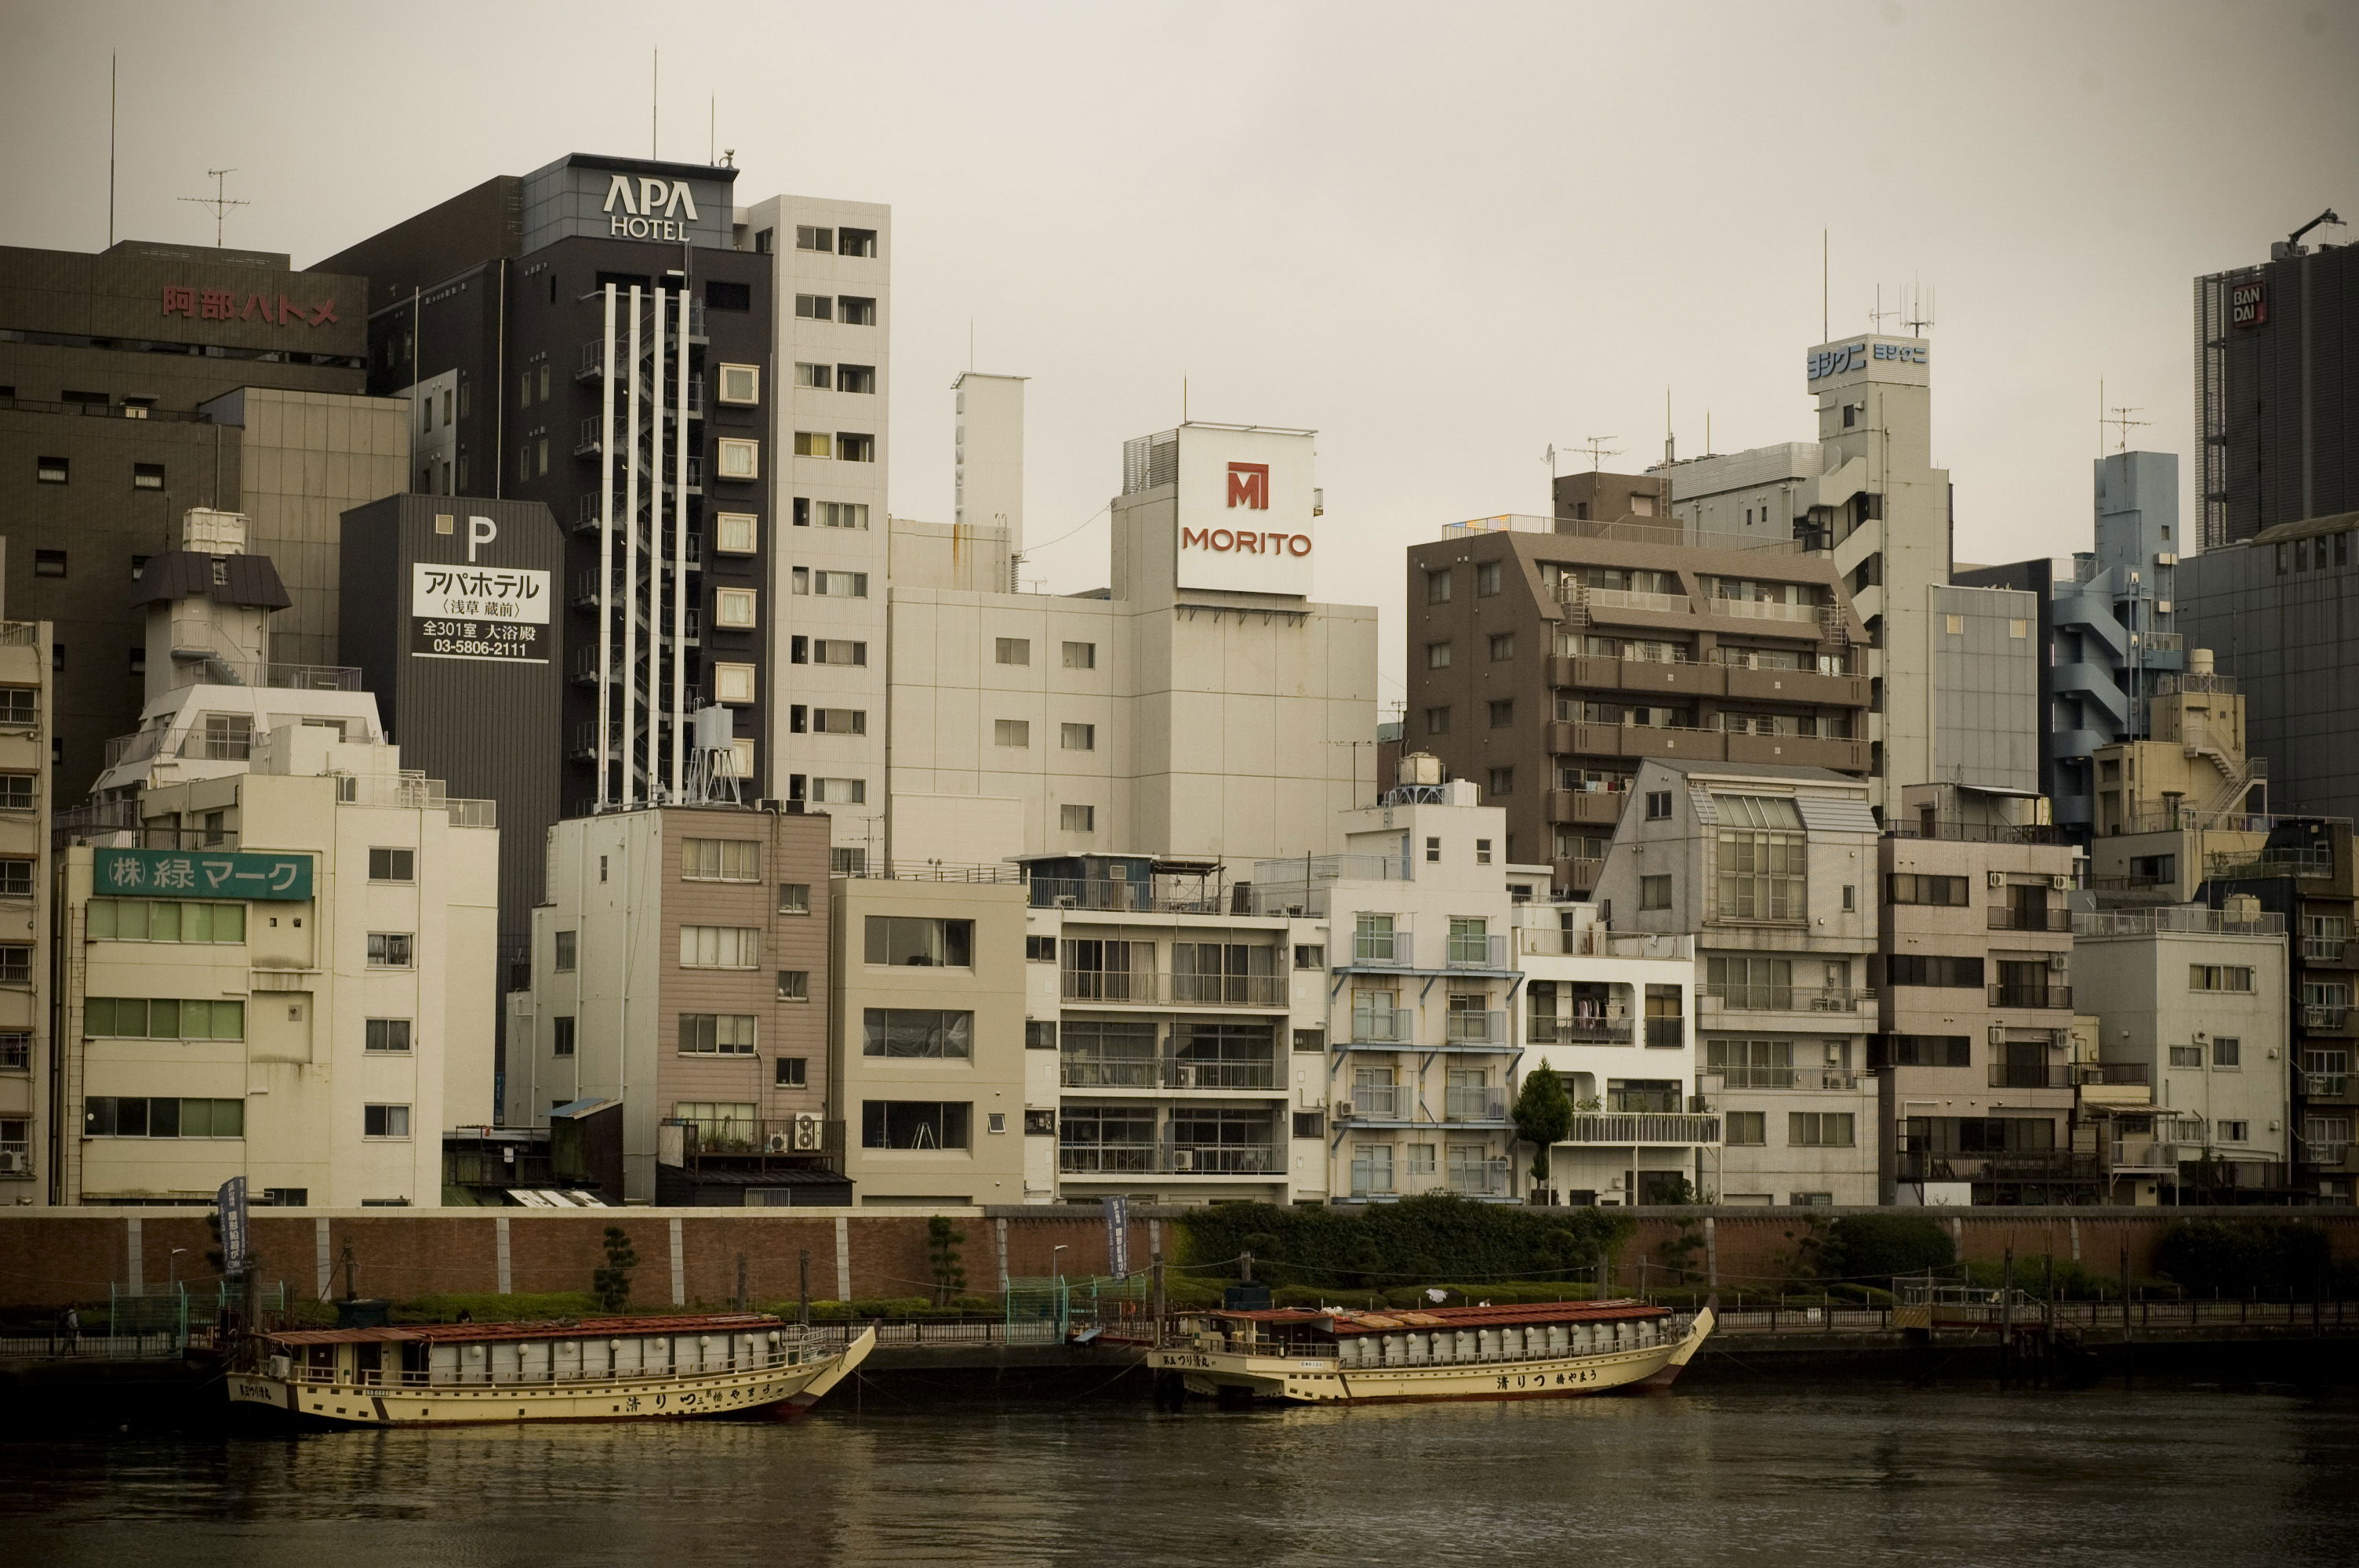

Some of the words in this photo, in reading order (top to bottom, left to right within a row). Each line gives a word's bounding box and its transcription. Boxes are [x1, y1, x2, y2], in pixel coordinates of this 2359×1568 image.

[603, 175, 698, 220] APA
[610, 216, 691, 241] HOTEL
[163, 285, 340, 327] 阿部ハトメ
[2234, 287, 2260, 306] BAN
[2234, 304, 2255, 322] DAI
[468, 515, 497, 562] P
[1182, 527, 1312, 557] MORITO
[423, 571, 540, 599] アパホテル
[423, 620, 478, 639] 全301室
[484, 623, 536, 642] 大浴殿
[433, 638, 526, 657] 03-5806-2111
